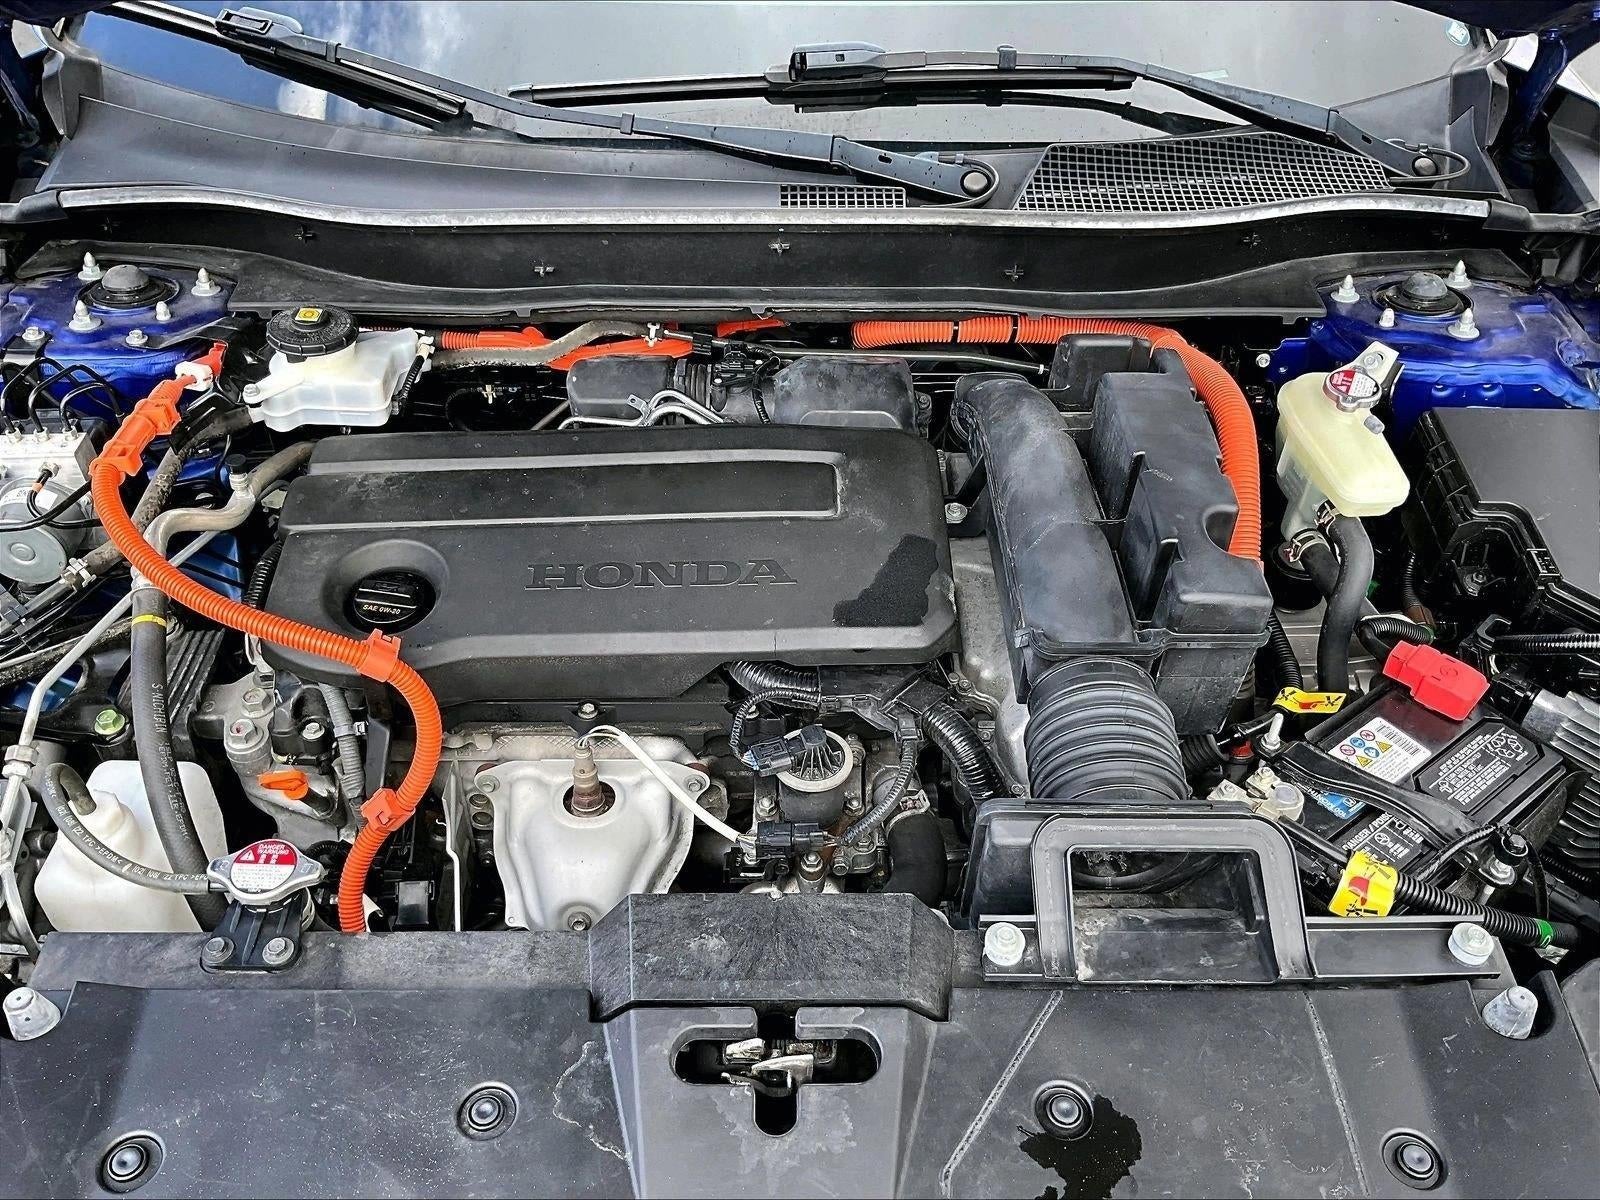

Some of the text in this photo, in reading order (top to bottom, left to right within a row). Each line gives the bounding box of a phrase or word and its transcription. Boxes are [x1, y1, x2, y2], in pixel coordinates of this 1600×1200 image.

[524, 559, 798, 591] HONDA
[362, 604, 379, 612] SAE
[1342, 828, 1371, 851] DANGER
